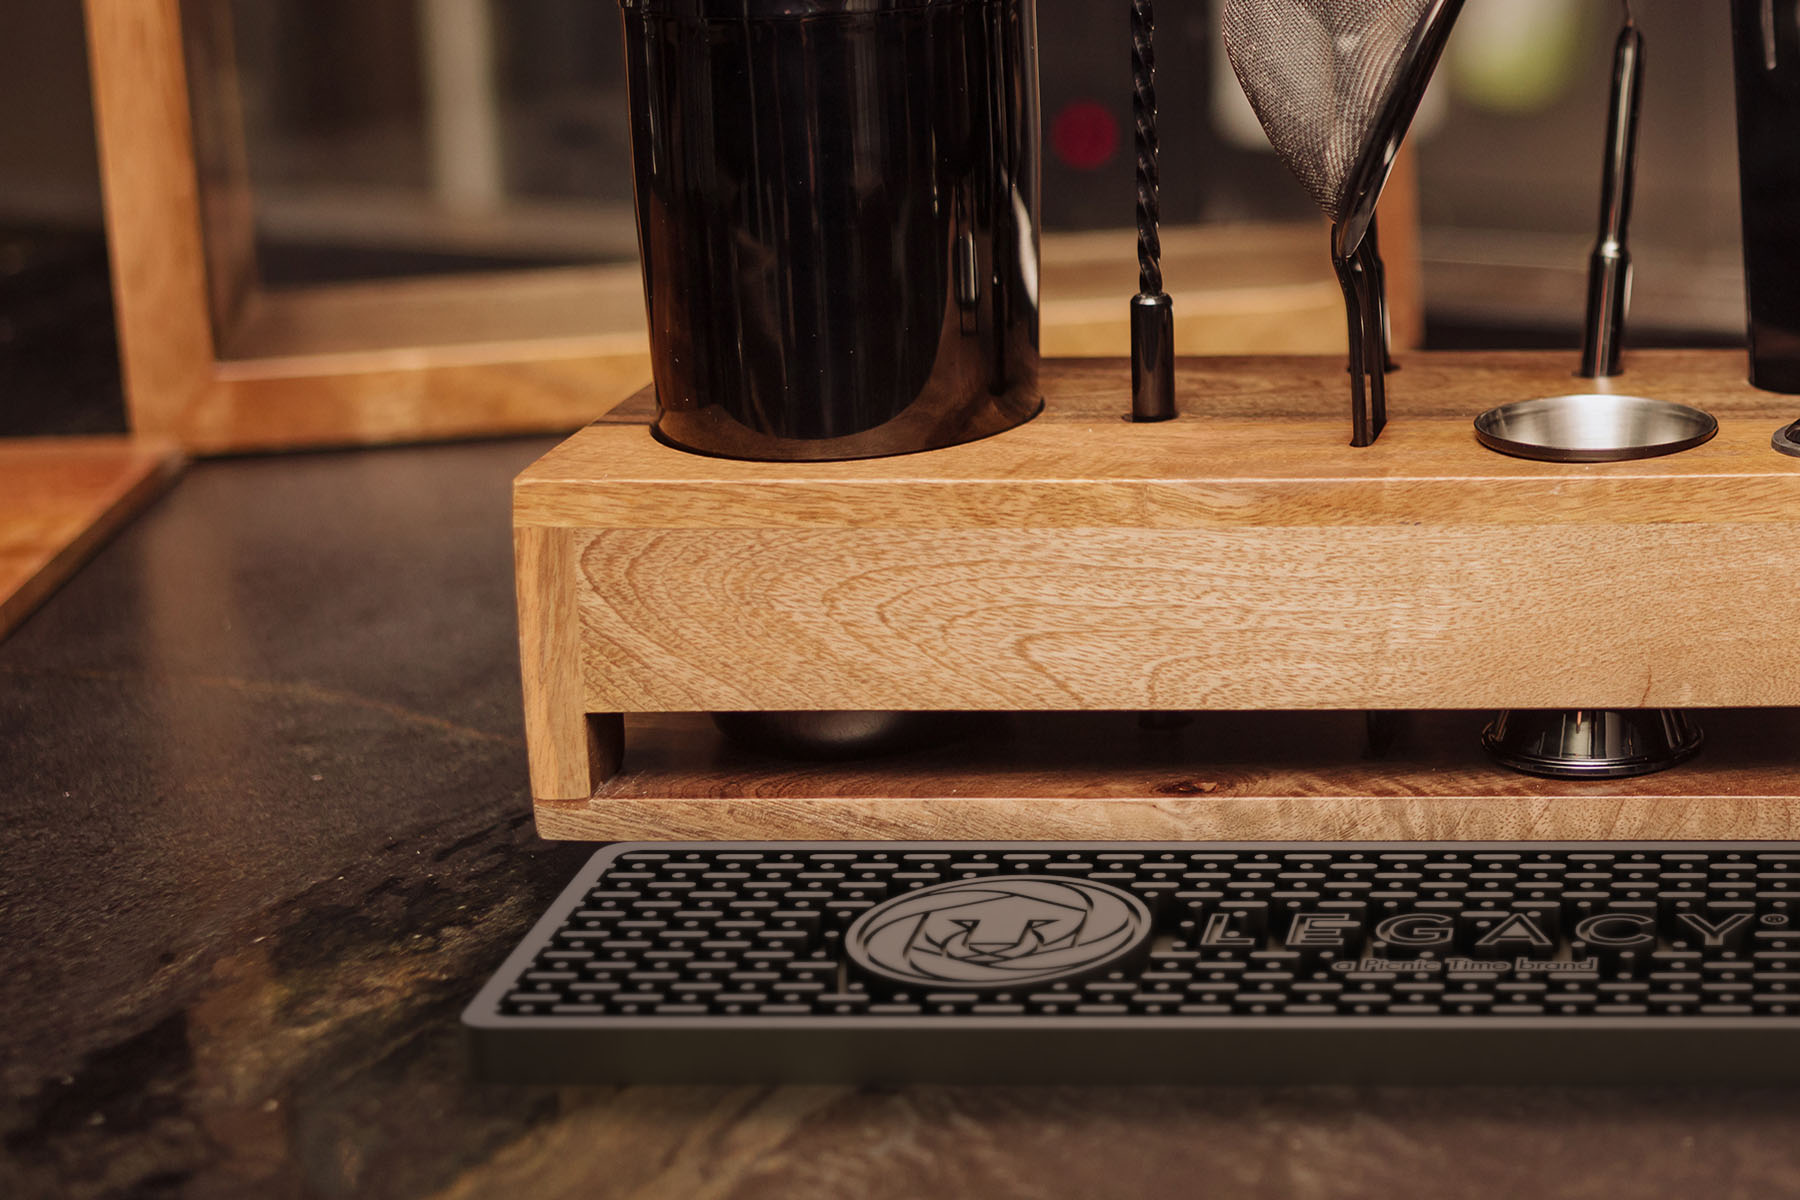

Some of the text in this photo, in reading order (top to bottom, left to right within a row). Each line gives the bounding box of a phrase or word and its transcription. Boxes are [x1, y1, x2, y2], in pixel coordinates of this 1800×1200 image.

[1359, 957, 1442, 971] Picnic
[1445, 957, 1512, 972] Time
[1514, 957, 1599, 971] brand
